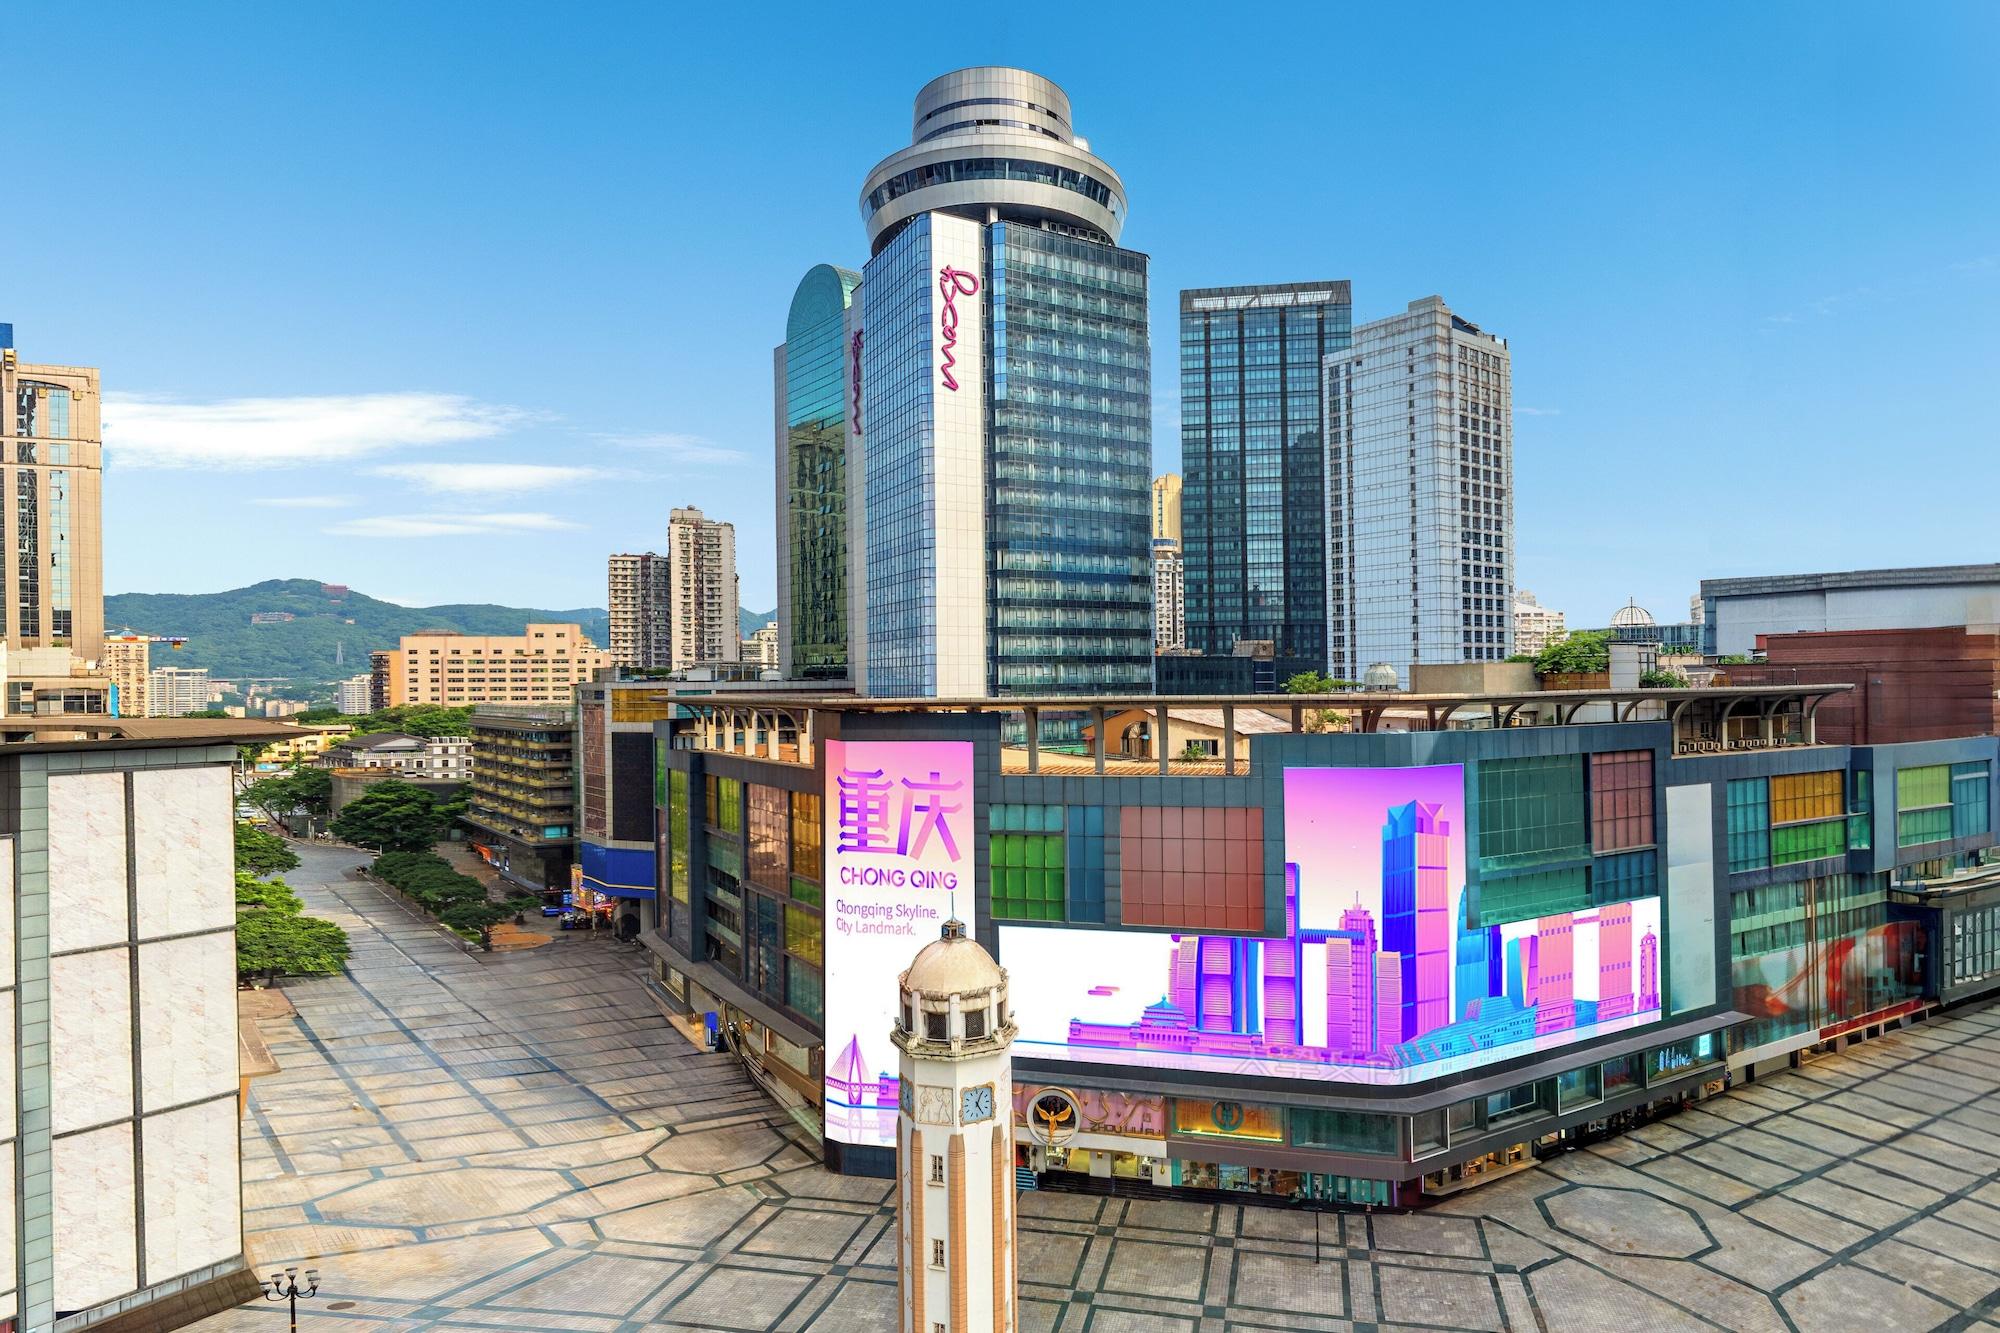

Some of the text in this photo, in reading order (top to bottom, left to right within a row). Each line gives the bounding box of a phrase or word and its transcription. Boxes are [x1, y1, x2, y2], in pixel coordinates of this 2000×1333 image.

[836, 767, 964, 863] 重庆
[840, 866, 958, 890] CHONG QING
[836, 898, 940, 921] Chongqing Skyline.
[836, 917, 917, 937] City Landmark.
